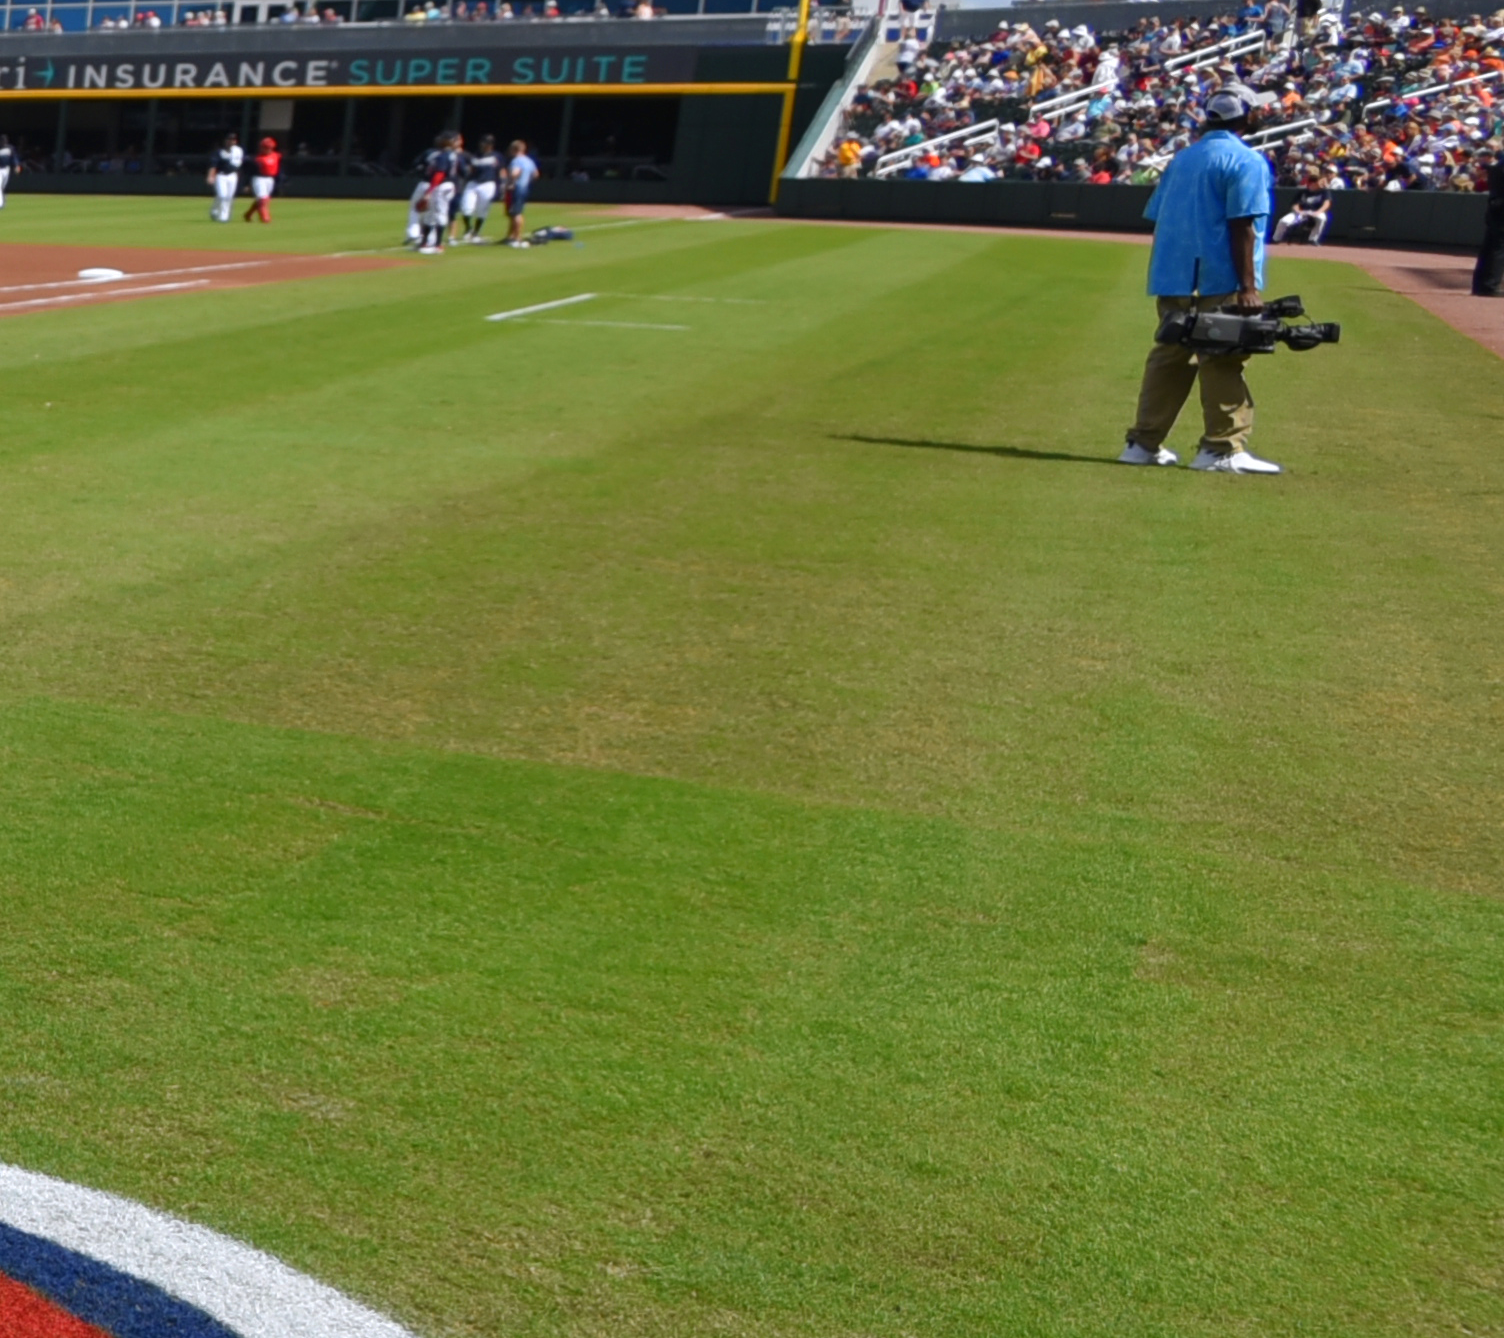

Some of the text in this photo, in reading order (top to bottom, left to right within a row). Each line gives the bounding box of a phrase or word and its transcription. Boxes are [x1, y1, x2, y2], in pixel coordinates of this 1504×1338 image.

[67, 60, 329, 89] INSURANCE
[348, 57, 491, 85] SUPER
[511, 55, 648, 84] SUITE
